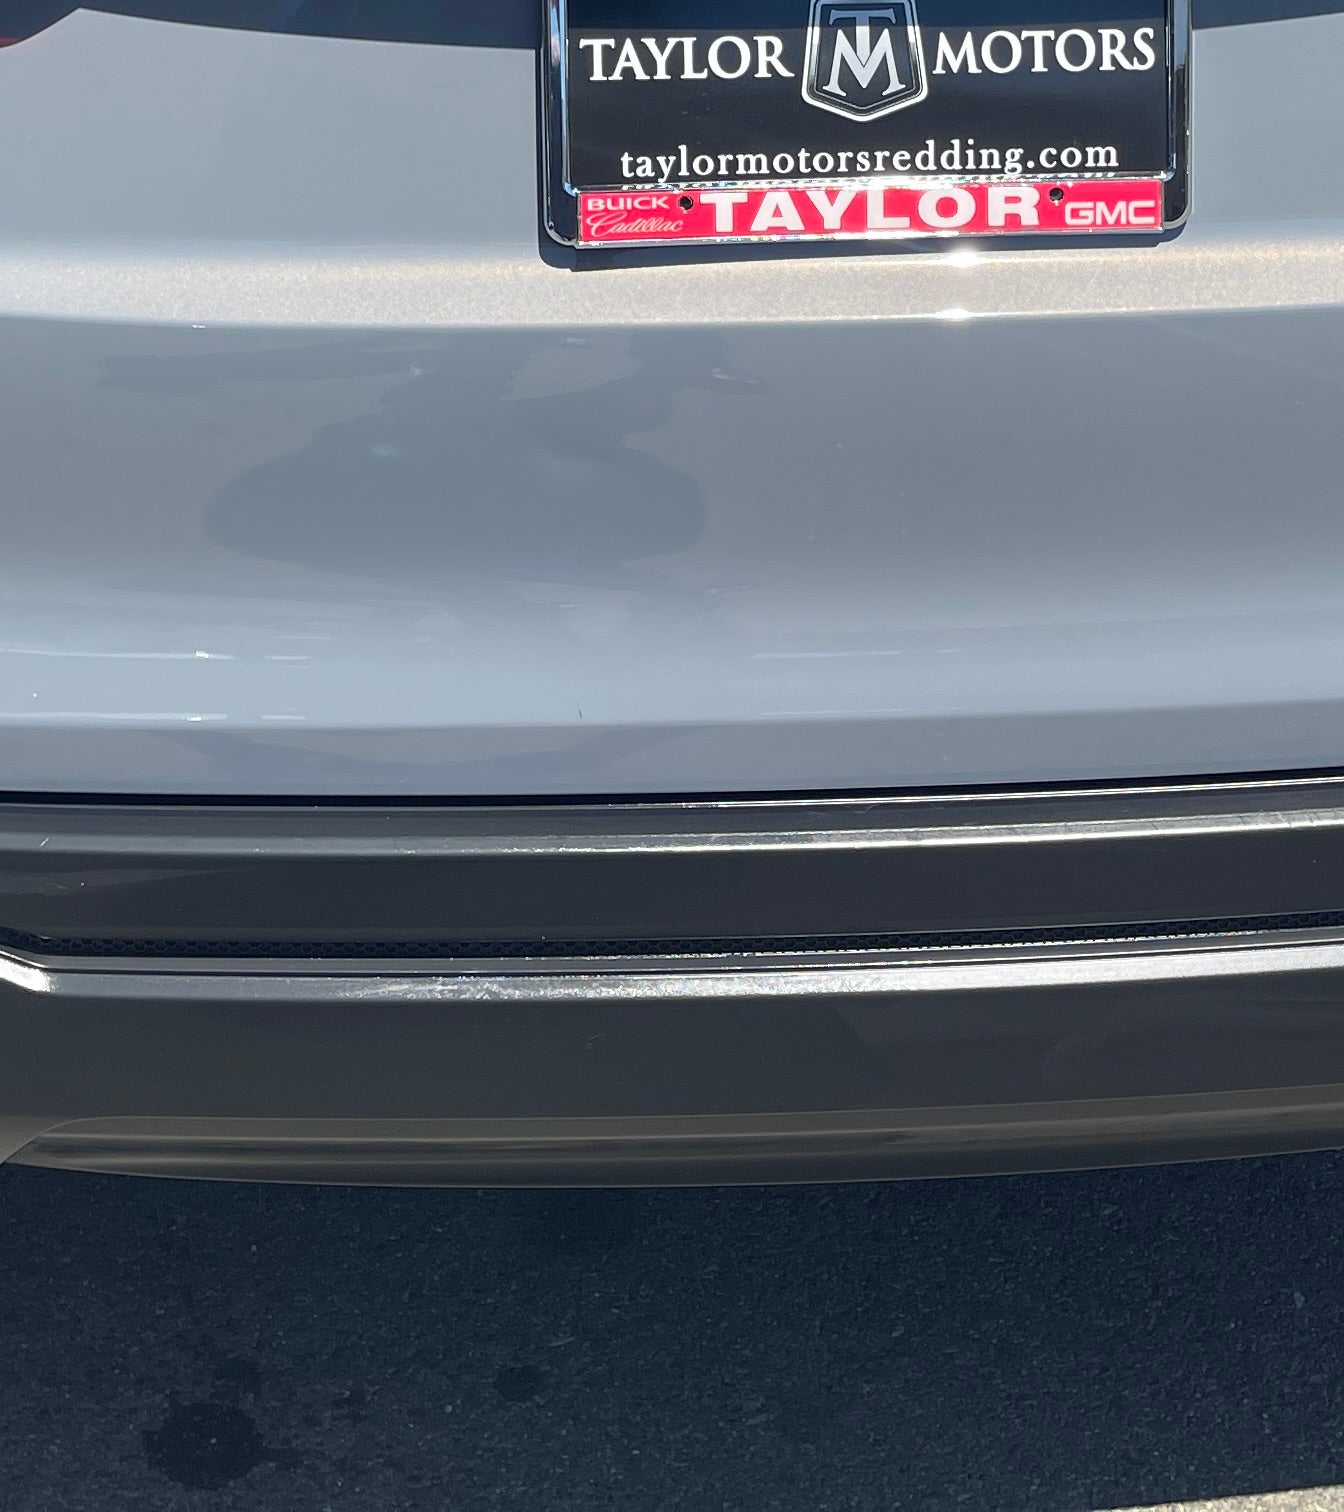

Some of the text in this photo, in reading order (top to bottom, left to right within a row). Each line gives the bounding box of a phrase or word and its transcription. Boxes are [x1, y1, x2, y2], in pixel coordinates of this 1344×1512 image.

[578, 36, 795, 81] TAYLOR
[932, 27, 1156, 74] MOTORS
[620, 138, 1119, 182] taylormotorsredding.com
[587, 195, 670, 212] BUICK
[699, 186, 1041, 232] TAYLOR
[1064, 200, 1156, 226] GMC
[586, 210, 684, 237] Cadillac
